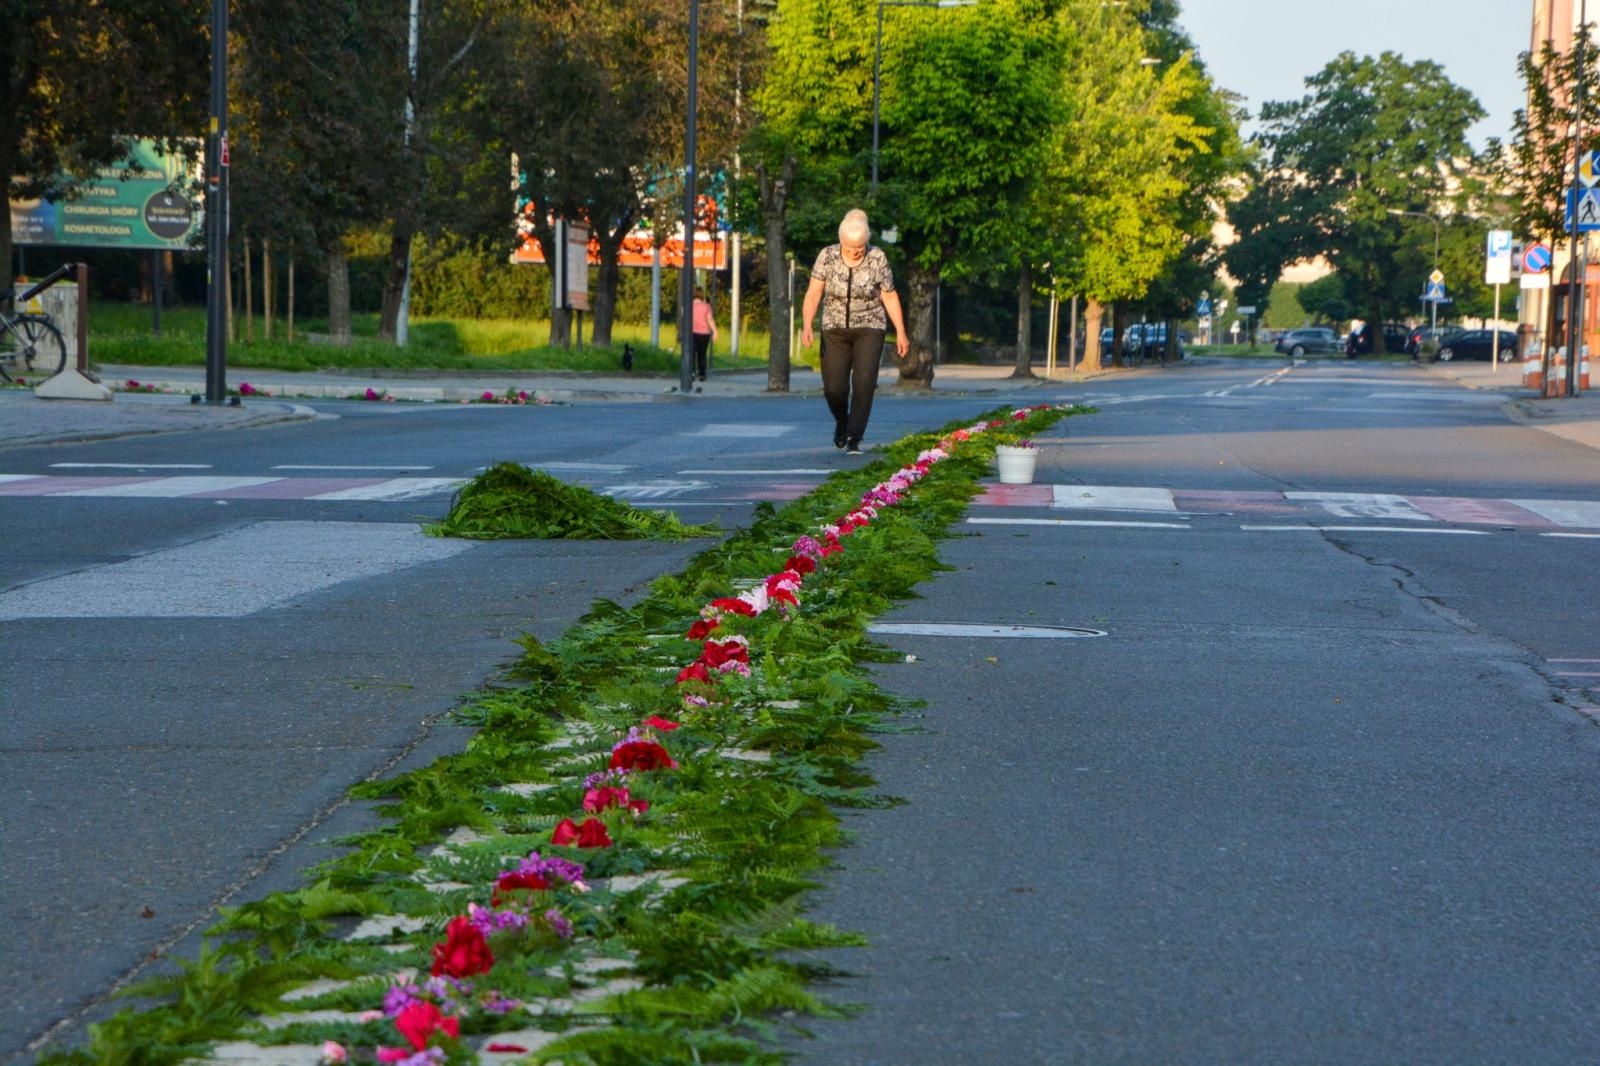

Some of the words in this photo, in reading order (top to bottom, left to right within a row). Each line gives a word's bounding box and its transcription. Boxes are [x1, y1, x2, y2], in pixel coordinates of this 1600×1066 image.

[63, 205, 111, 216] CHIRURGIA
[111, 206, 138, 217] SKÓRY
[63, 223, 131, 235] KOSMETOLOGIA
